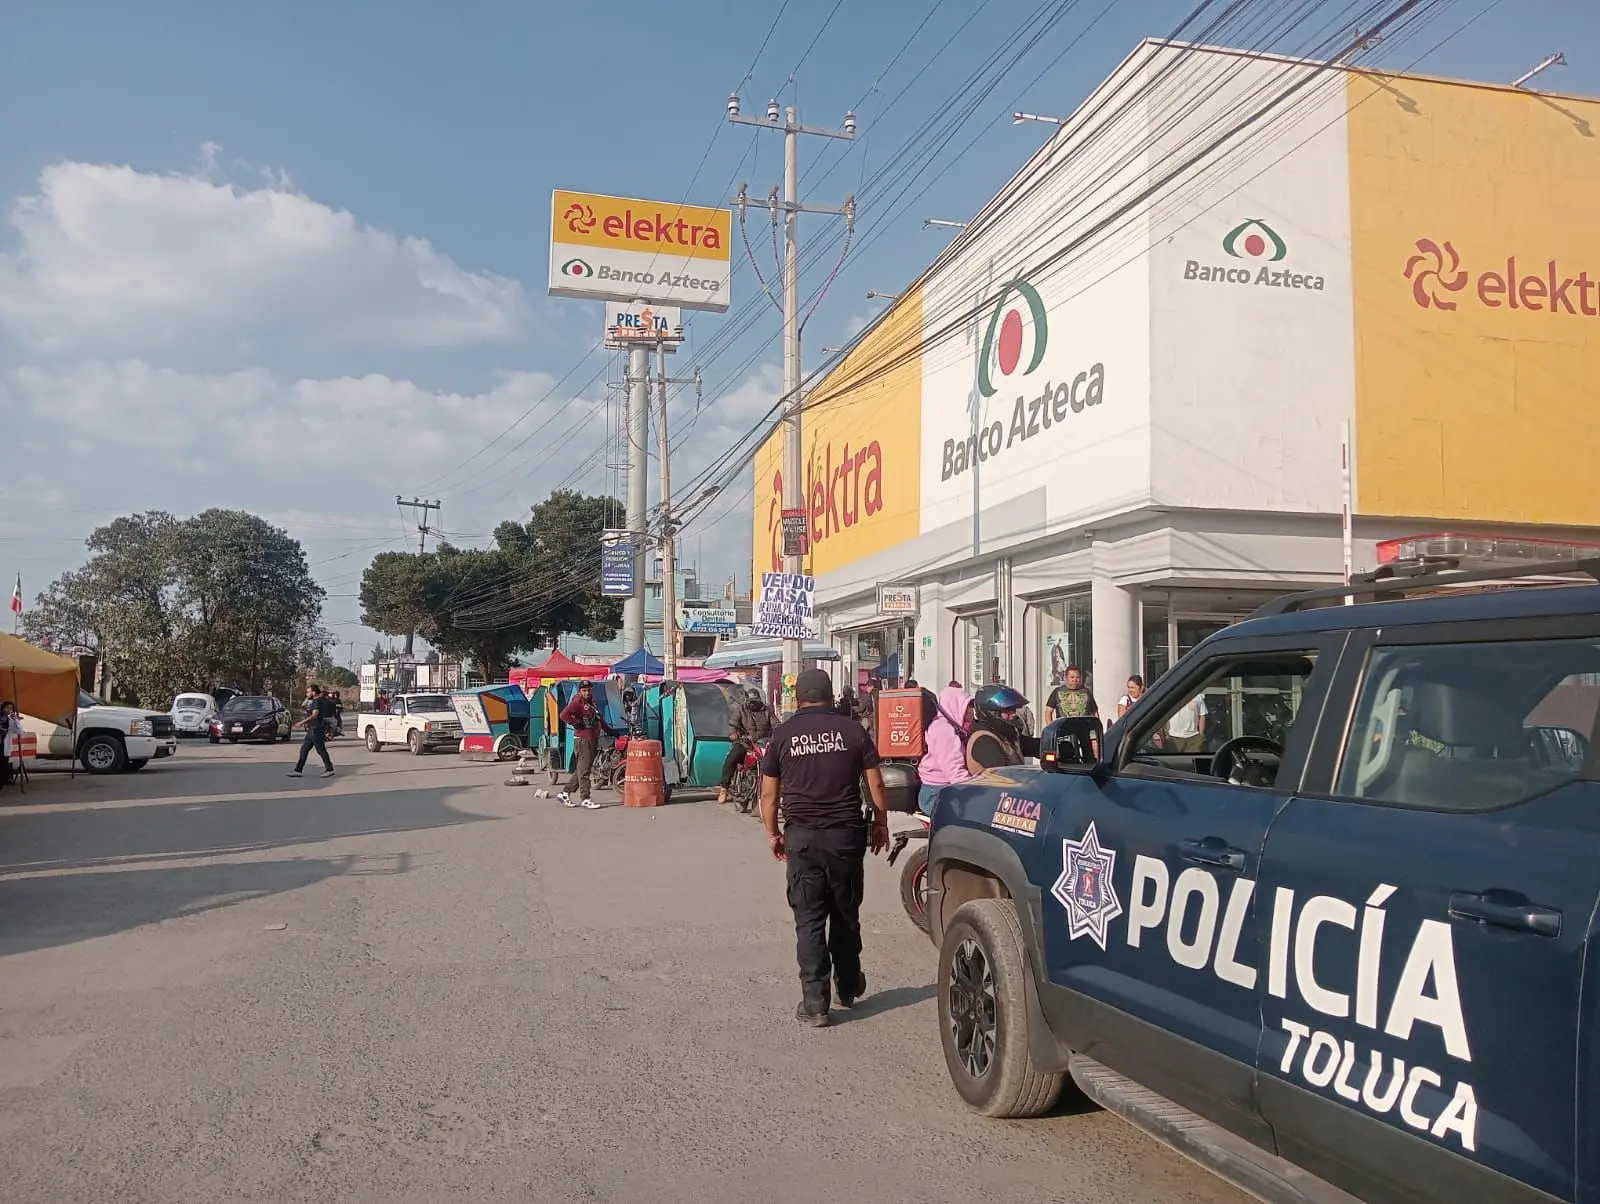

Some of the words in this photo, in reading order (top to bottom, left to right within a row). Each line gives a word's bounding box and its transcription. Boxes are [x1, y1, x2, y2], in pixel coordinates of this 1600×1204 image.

[603, 210, 720, 249] elektra
[597, 265, 654, 285] Banco
[657, 271, 720, 291] Azteca
[1184, 260, 1251, 284] Banco
[1254, 266, 1325, 291] Azteca
[1477, 256, 1600, 316] elekt
[941, 420, 1003, 482] Banco
[1006, 362, 1105, 449] Azteca
[800, 440, 883, 548] lektra
[761, 573, 815, 592] VENDO
[764, 587, 808, 607] CASA
[692, 609, 734, 617] Consultorio
[760, 612, 804, 626] COMERCIAL
[782, 602, 812, 618] PLANTA
[791, 730, 843, 746] POLICÍA
[890, 730, 910, 742] 6%
[790, 742, 848, 757] MUNICIPAL
[996, 792, 1041, 820] TOLUCA
[995, 814, 1034, 830] CAPITAL
[1127, 854, 1472, 1062] POLICÍA
[1280, 1017, 1478, 1153] TOLUCA
